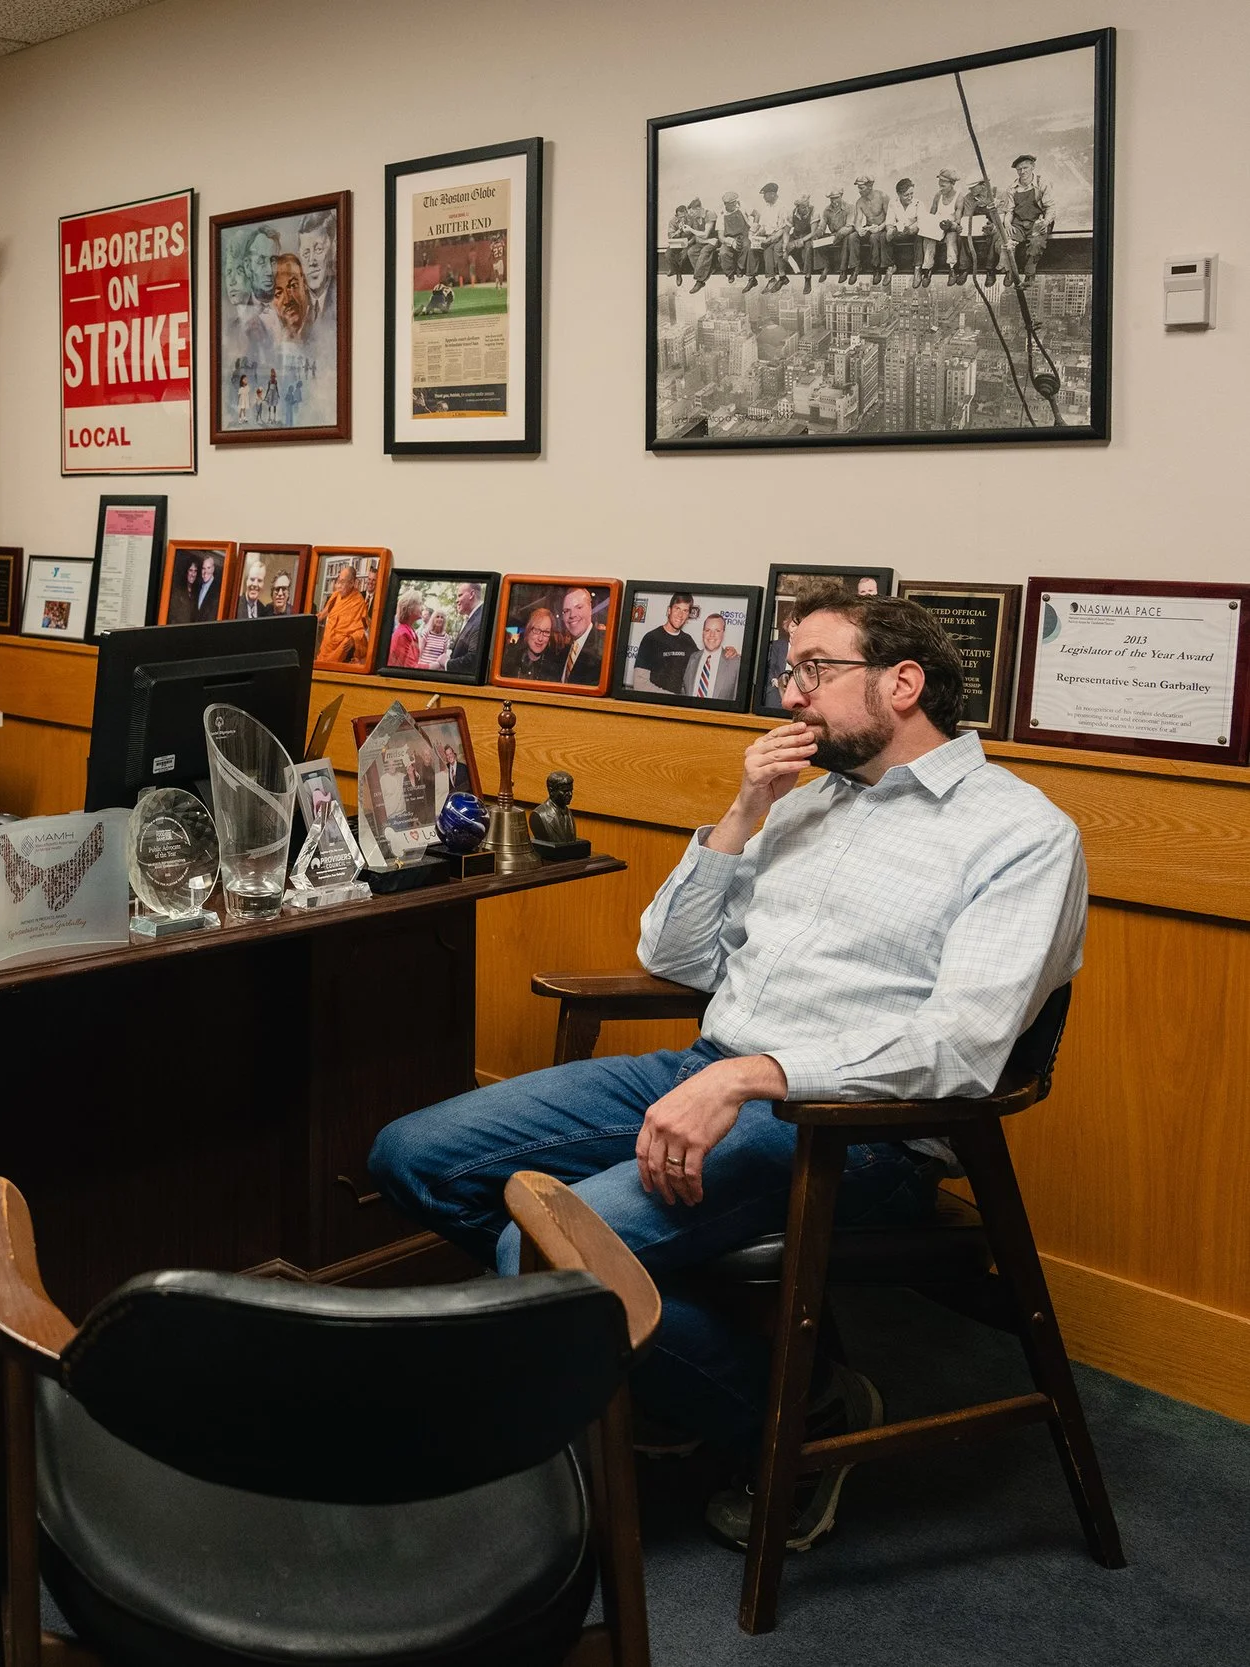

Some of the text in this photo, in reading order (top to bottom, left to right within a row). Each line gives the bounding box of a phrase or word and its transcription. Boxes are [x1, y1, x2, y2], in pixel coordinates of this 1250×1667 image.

[423, 187, 496, 208] The Boston Globe
[428, 217, 491, 236] A BITTER END
[65, 221, 185, 274] LABORERS
[493, 247, 503, 258] 23
[108, 274, 139, 311] ON
[65, 312, 189, 388] STRIKE
[70, 427, 131, 448] LOCAL
[720, 611, 746, 619] BOSTO
[952, 609, 987, 617] OFFICIAL
[1080, 605, 1162, 617] NASW-MA PACE
[1123, 635, 1148, 645] 2013
[1060, 645, 1214, 662] Legislator of the Year Award
[1056, 673, 1211, 694] Representative Sean Garballey
[1084, 706, 1113, 714] recognition
[35, 832, 74, 842] MAMH
[321, 853, 351, 864] PROVIDERS
